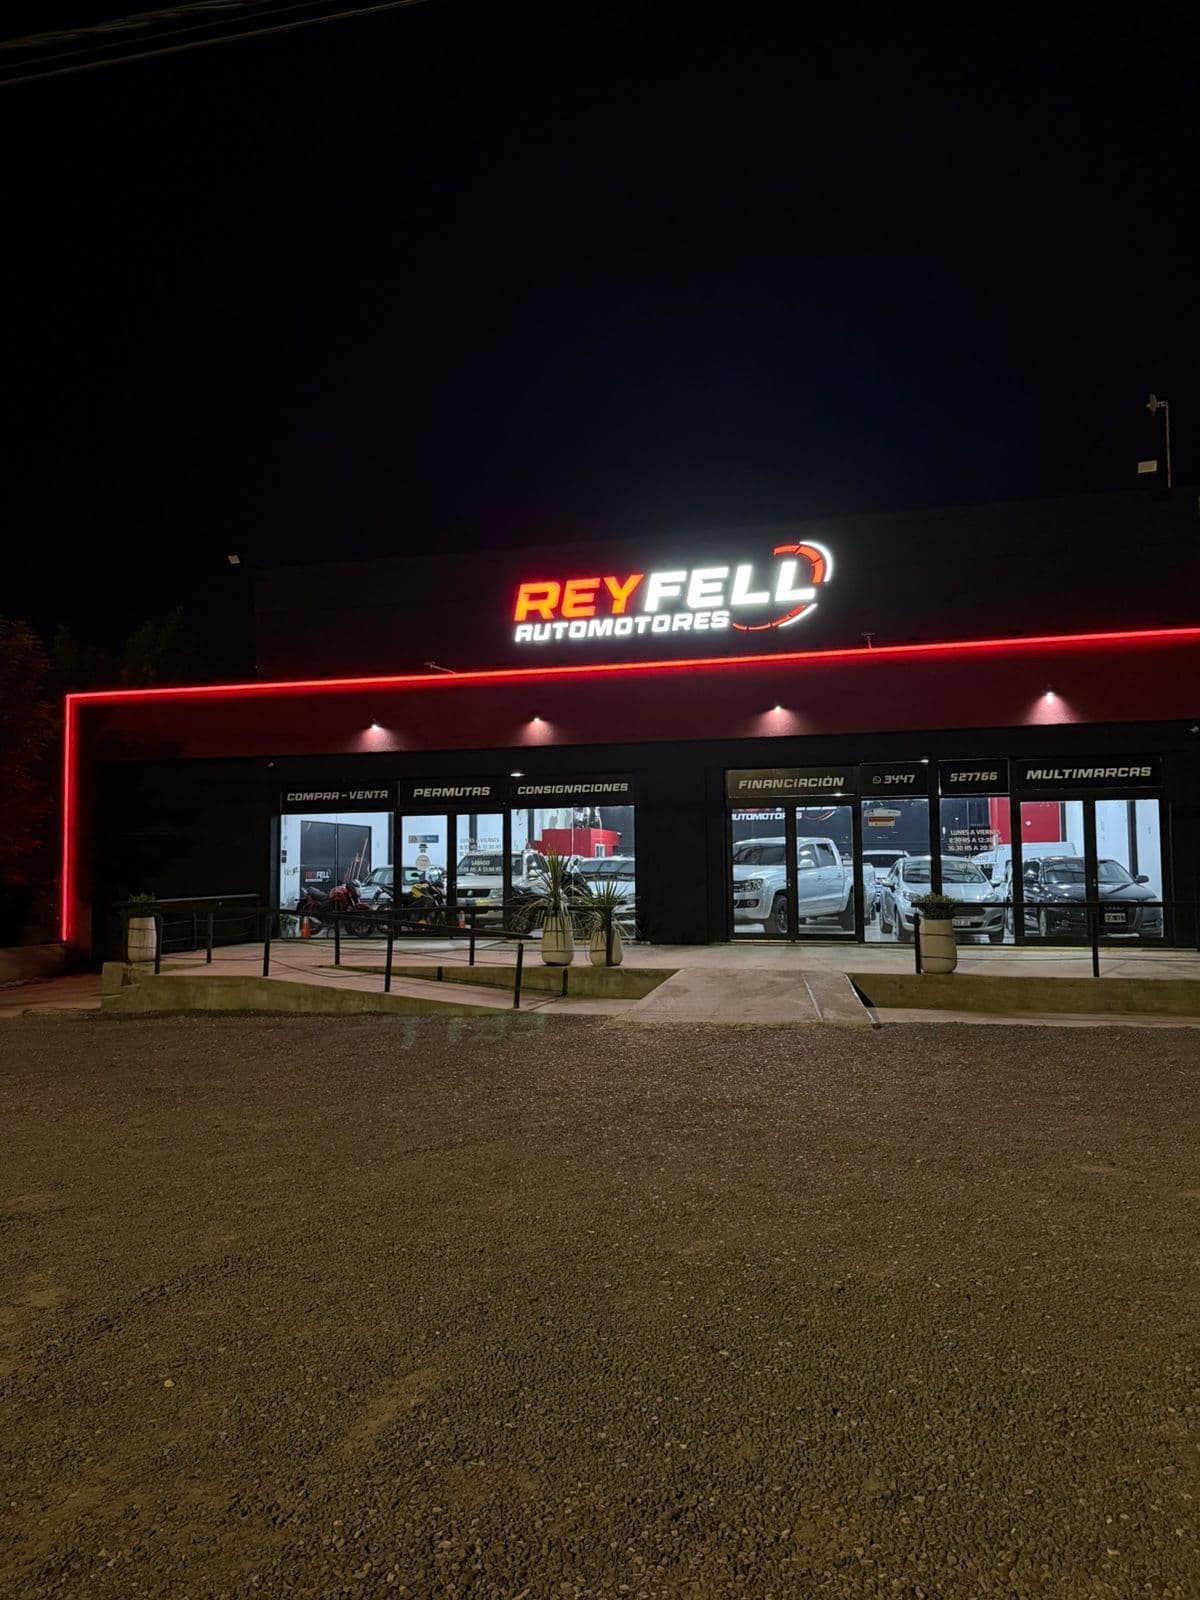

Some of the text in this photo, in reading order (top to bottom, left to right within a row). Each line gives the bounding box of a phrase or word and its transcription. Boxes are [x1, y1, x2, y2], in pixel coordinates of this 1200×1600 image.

[514, 610, 729, 642] AUTOMOTORES
[950, 771, 998, 782] 527766
[1025, 766, 1152, 780] MULTIMARCAS
[738, 776, 844, 790] FINANCIACIÓN
[884, 774, 915, 785] 3447
[413, 786, 490, 798] PERMUTAS
[517, 782, 629, 795] CONSIGNACIONES
[287, 791, 339, 801] COMPRA
[349, 789, 388, 800] VENTA
